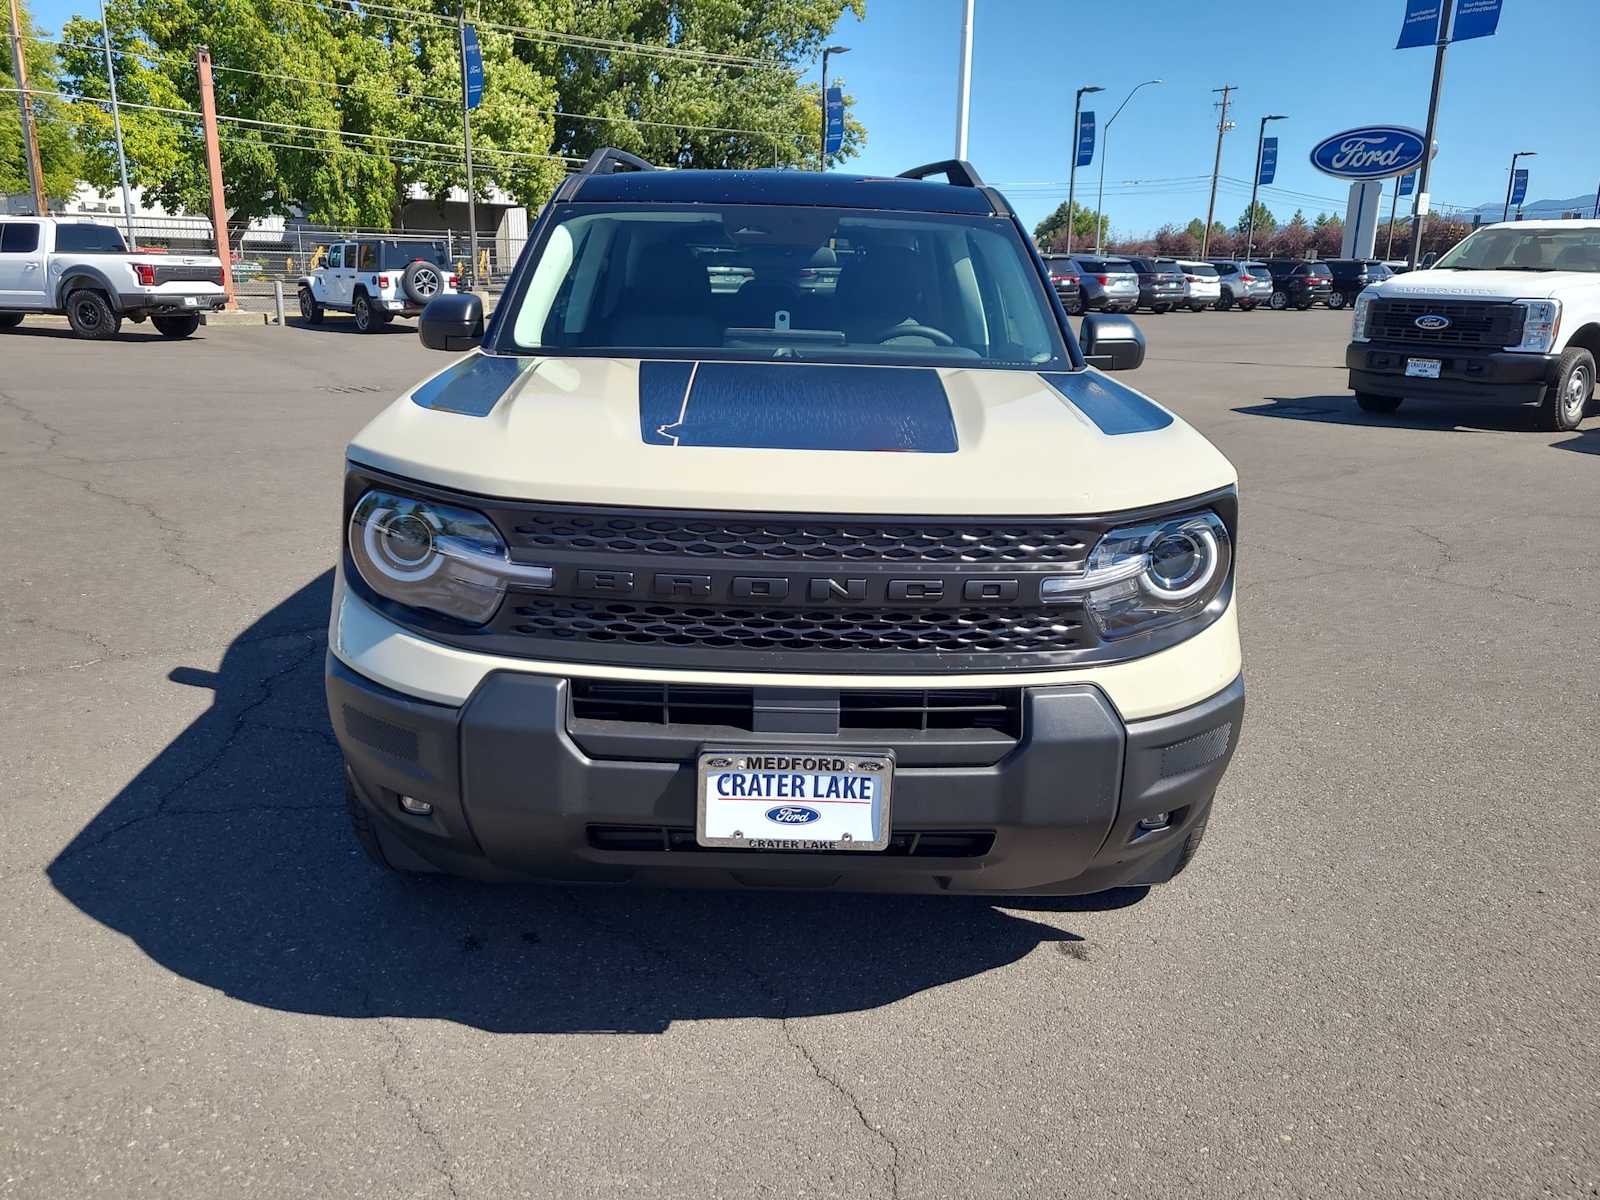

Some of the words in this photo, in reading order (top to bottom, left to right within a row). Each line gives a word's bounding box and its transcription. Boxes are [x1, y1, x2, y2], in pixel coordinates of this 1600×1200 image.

[1331, 137, 1405, 169] Ford
[576, 569, 1019, 601] BRONCO
[746, 756, 845, 771] MEDFORD
[717, 773, 805, 798] CRATER
[813, 775, 871, 800] LAKE
[776, 807, 810, 823] Ford
[749, 839, 800, 848] CRATER
[803, 840, 839, 849] LAKE
